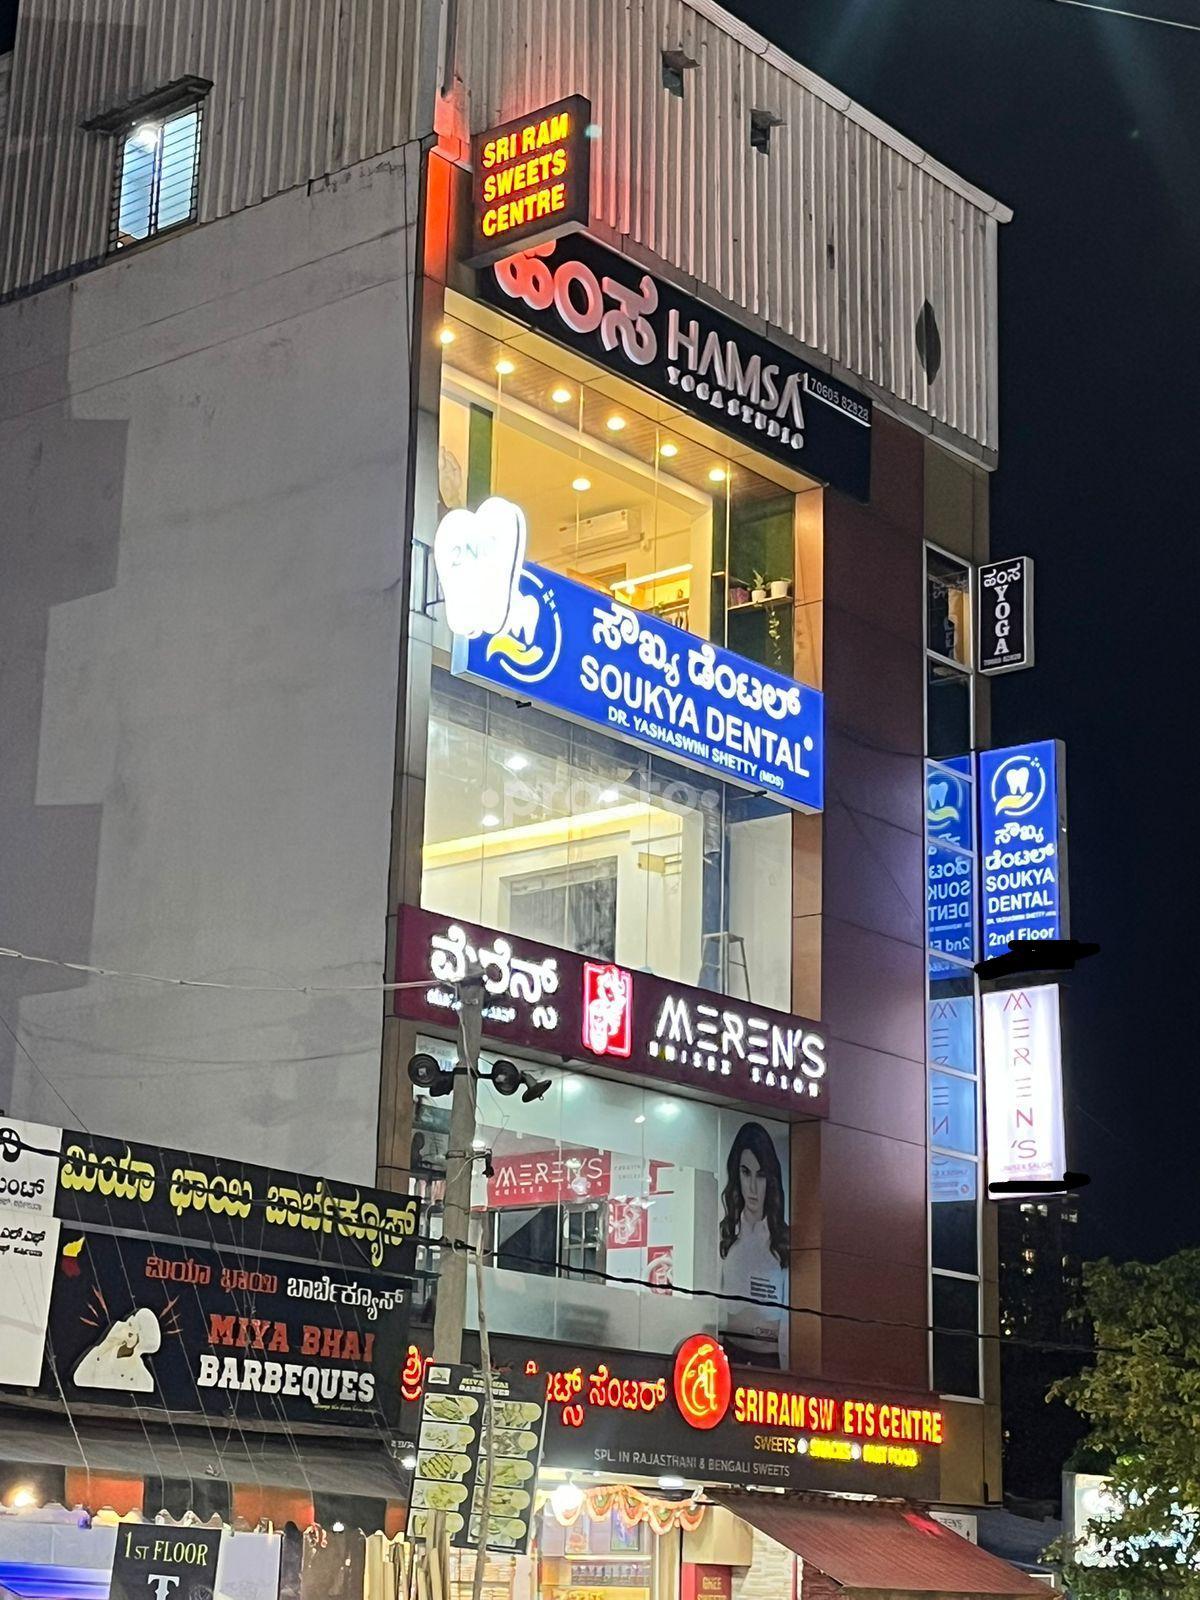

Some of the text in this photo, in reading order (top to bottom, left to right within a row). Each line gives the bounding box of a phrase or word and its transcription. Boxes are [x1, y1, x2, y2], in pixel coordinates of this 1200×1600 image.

[482, 111, 570, 169] SRI RAM
[482, 147, 568, 203] SWEETS
[481, 182, 565, 237] CENTRE
[668, 308, 806, 430] HAMSA
[666, 365, 805, 450] YOGA STUDIO
[983, 562, 1021, 588] ಹಂಸ
[993, 584, 1011, 656] YOGA
[592, 602, 802, 720] ಸೌಖ್ಯ ಡೆಂಟಲ್
[579, 654, 811, 779] SOUKYA DENTAL
[607, 705, 631, 729] DR.
[632, 714, 710, 760] YASHASWINI
[711, 747, 759, 779] SHETTY
[985, 843, 1056, 872] ಡೆಂಟಲ್
[986, 868, 1056, 892] SOUKYA
[988, 890, 1054, 914] DENTAL
[988, 927, 1055, 947] 2nd Floor
[656, 994, 827, 1079] MEREN'S
[1003, 990, 1038, 1159] MEREN'S
[145, 1254, 212, 1286] ಮಿಯಾ
[207, 1313, 377, 1364] MIYA BHAI
[196, 1353, 376, 1405] BARBEQUES
[588, 1363, 667, 1412] ಸೆಂಟರ್
[734, 1386, 764, 1424] SRI
[765, 1390, 805, 1428] RAM
[878, 1403, 944, 1444] CENTRE
[618, 1450, 630, 1463] IN
[631, 1450, 697, 1469] RAJASTHANI
[707, 1457, 750, 1475] BENGALI
[752, 1462, 791, 1478] SWEETS
[753, 1434, 797, 1455] SWEETS
[152, 1540, 209, 1567] FLOOR
